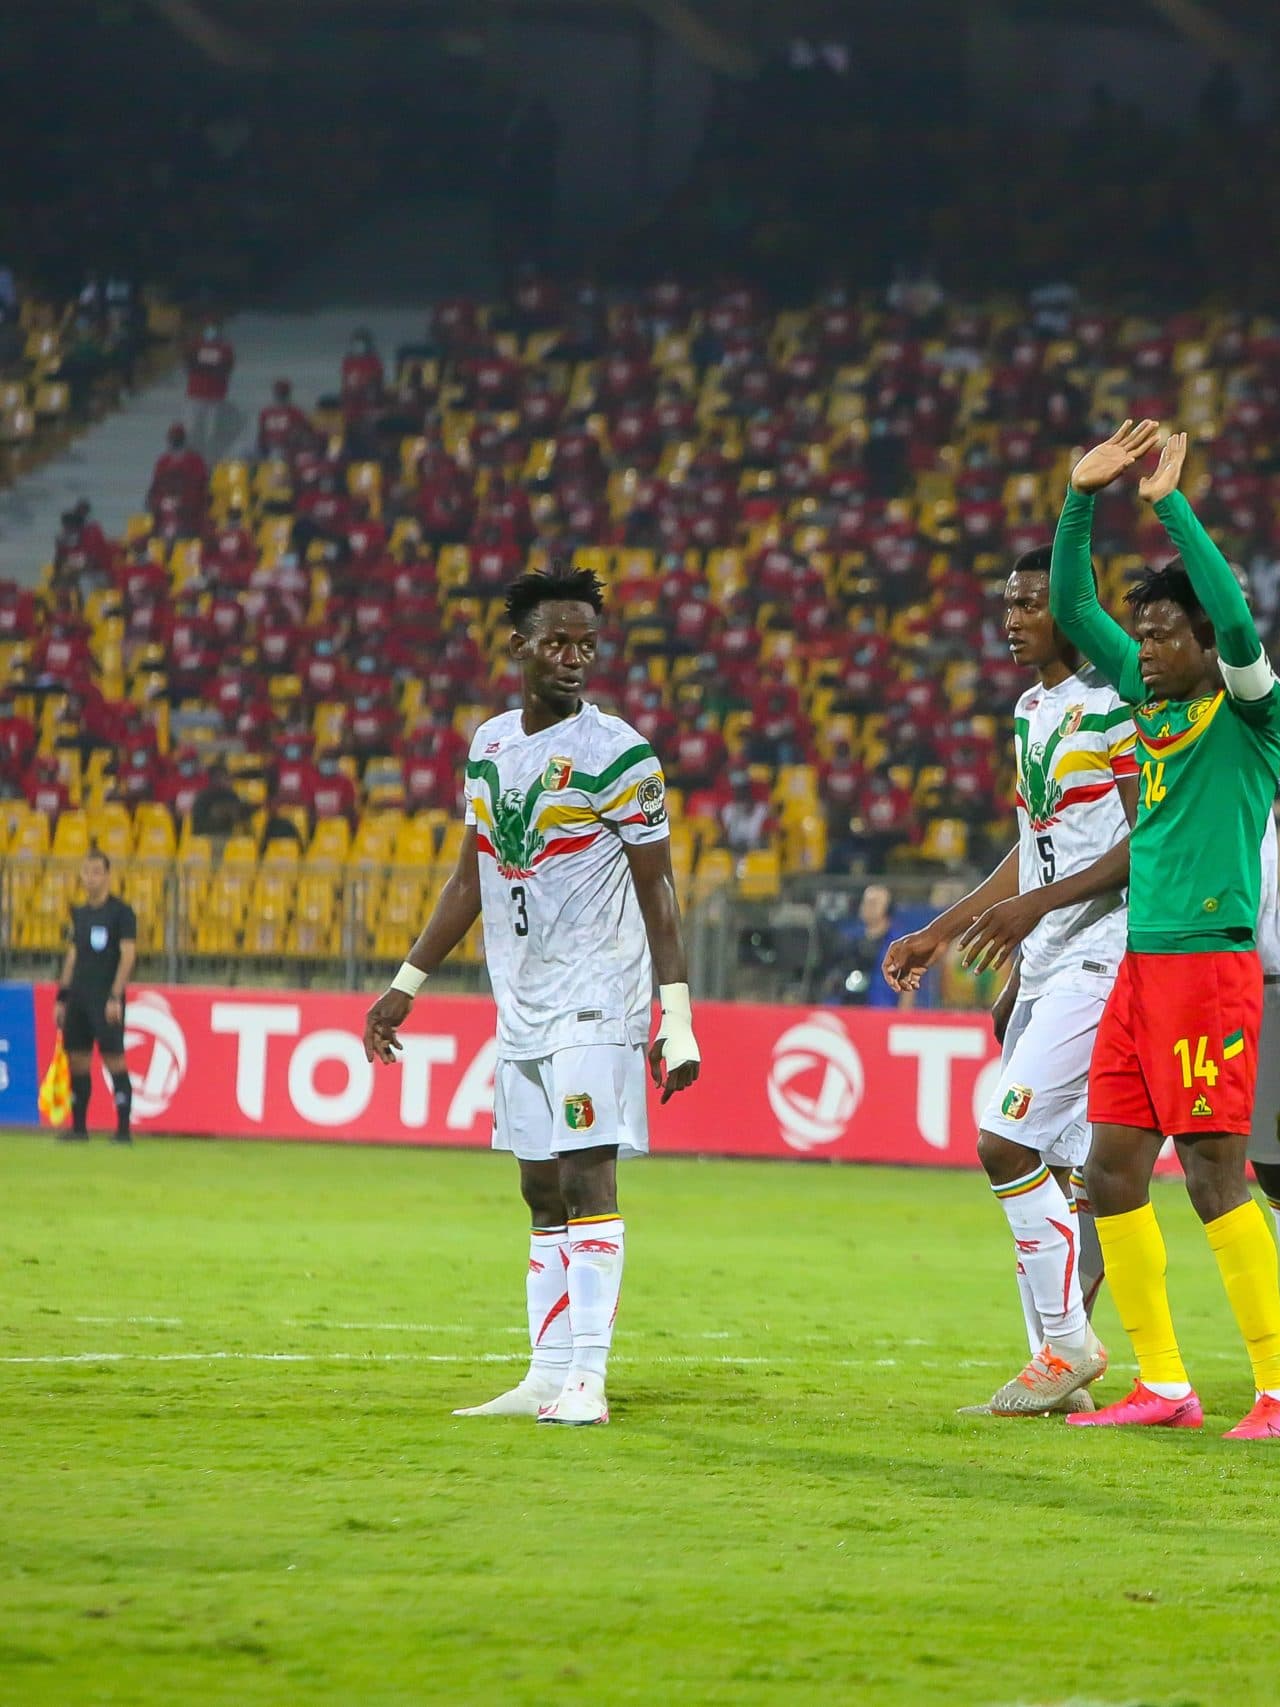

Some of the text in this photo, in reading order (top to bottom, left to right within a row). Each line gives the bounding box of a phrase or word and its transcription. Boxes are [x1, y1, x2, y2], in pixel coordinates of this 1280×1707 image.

[1142, 760, 1167, 811] 14
[1036, 834, 1056, 885] 5
[511, 885, 529, 937] 3
[211, 1004, 497, 1130] TOT
[1173, 1035, 1219, 1088] 14
